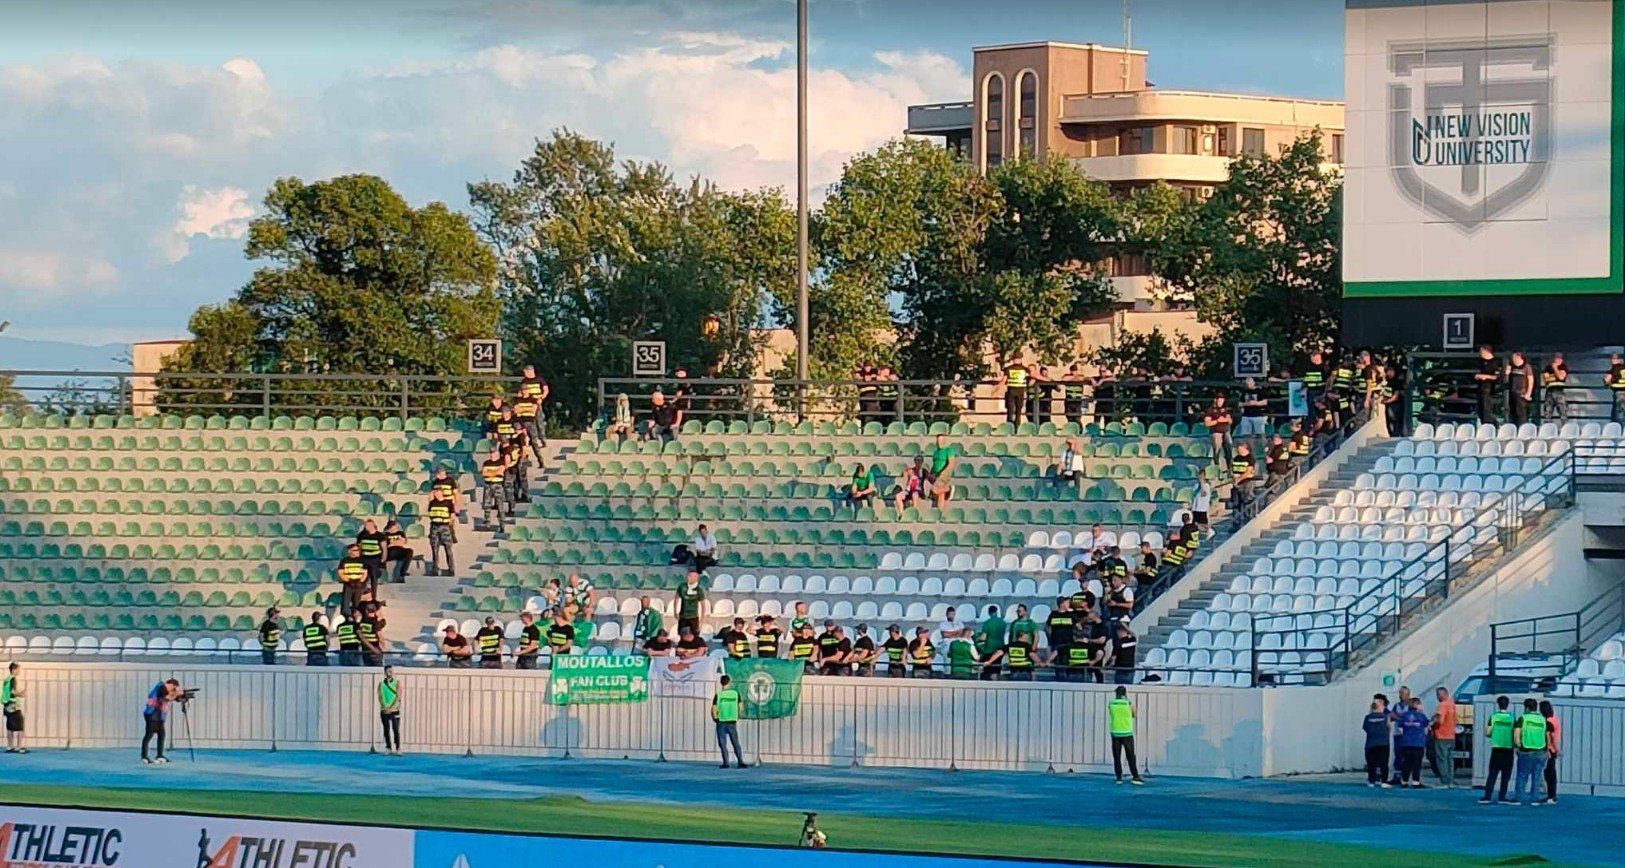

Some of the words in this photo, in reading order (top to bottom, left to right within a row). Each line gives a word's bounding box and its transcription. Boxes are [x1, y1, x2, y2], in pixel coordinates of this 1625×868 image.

[1435, 115, 1472, 138] NEW
[1477, 112, 1531, 137] VISION
[1435, 139, 1531, 165] UNIVERSITY
[1454, 319, 1462, 336] 1
[473, 344, 494, 361] 34
[639, 346, 660, 363] 35
[1240, 348, 1261, 365] 35
[557, 655, 645, 669] MOUTALLOS
[570, 676, 594, 687] FAN
[596, 675, 629, 686] CLUB
[208, 835, 357, 868] ATHLETIC
